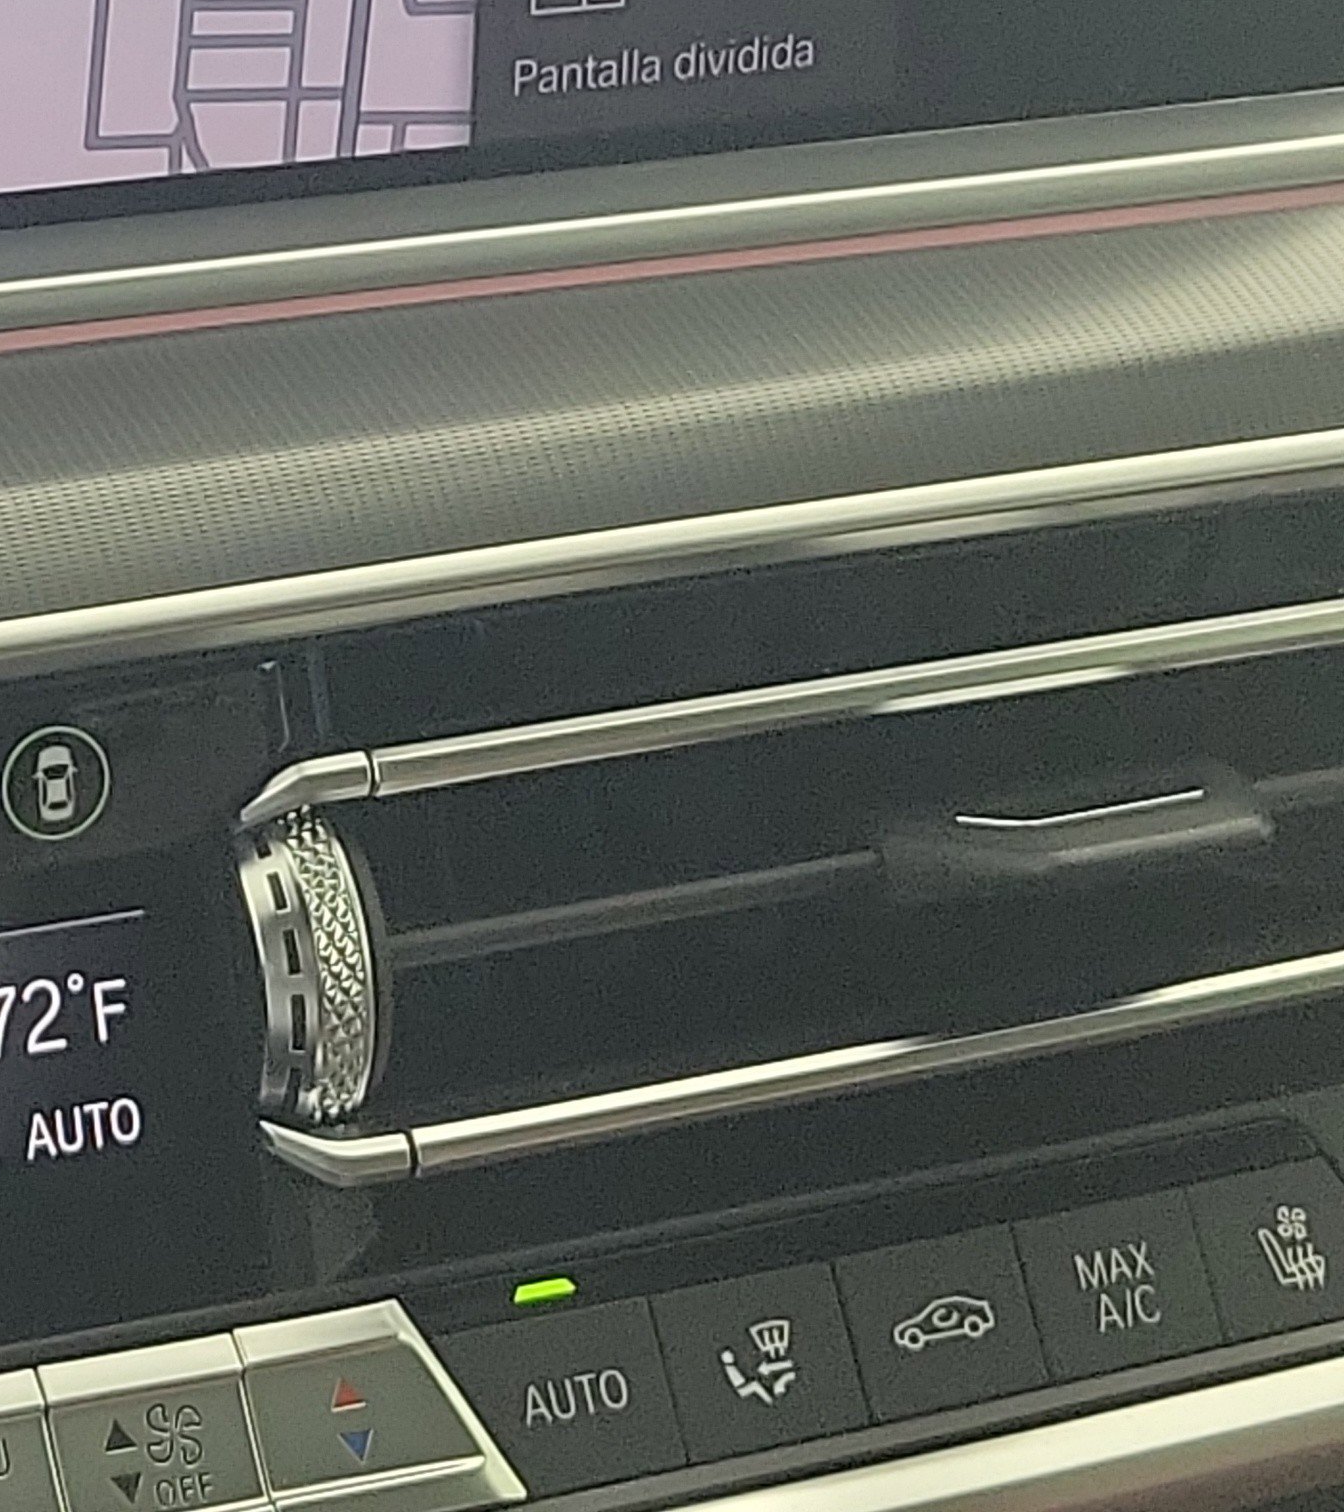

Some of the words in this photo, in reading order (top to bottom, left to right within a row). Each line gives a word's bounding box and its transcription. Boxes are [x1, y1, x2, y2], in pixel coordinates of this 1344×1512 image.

[514, 44, 661, 96] Pantalla
[674, 33, 813, 80] dividida
[27, 1098, 141, 1161] AUTO
[1073, 1242, 1156, 1289] MAX
[1097, 1286, 1162, 1332] A/C
[523, 1368, 630, 1428] AUTO
[154, 1471, 212, 1510] OFF
